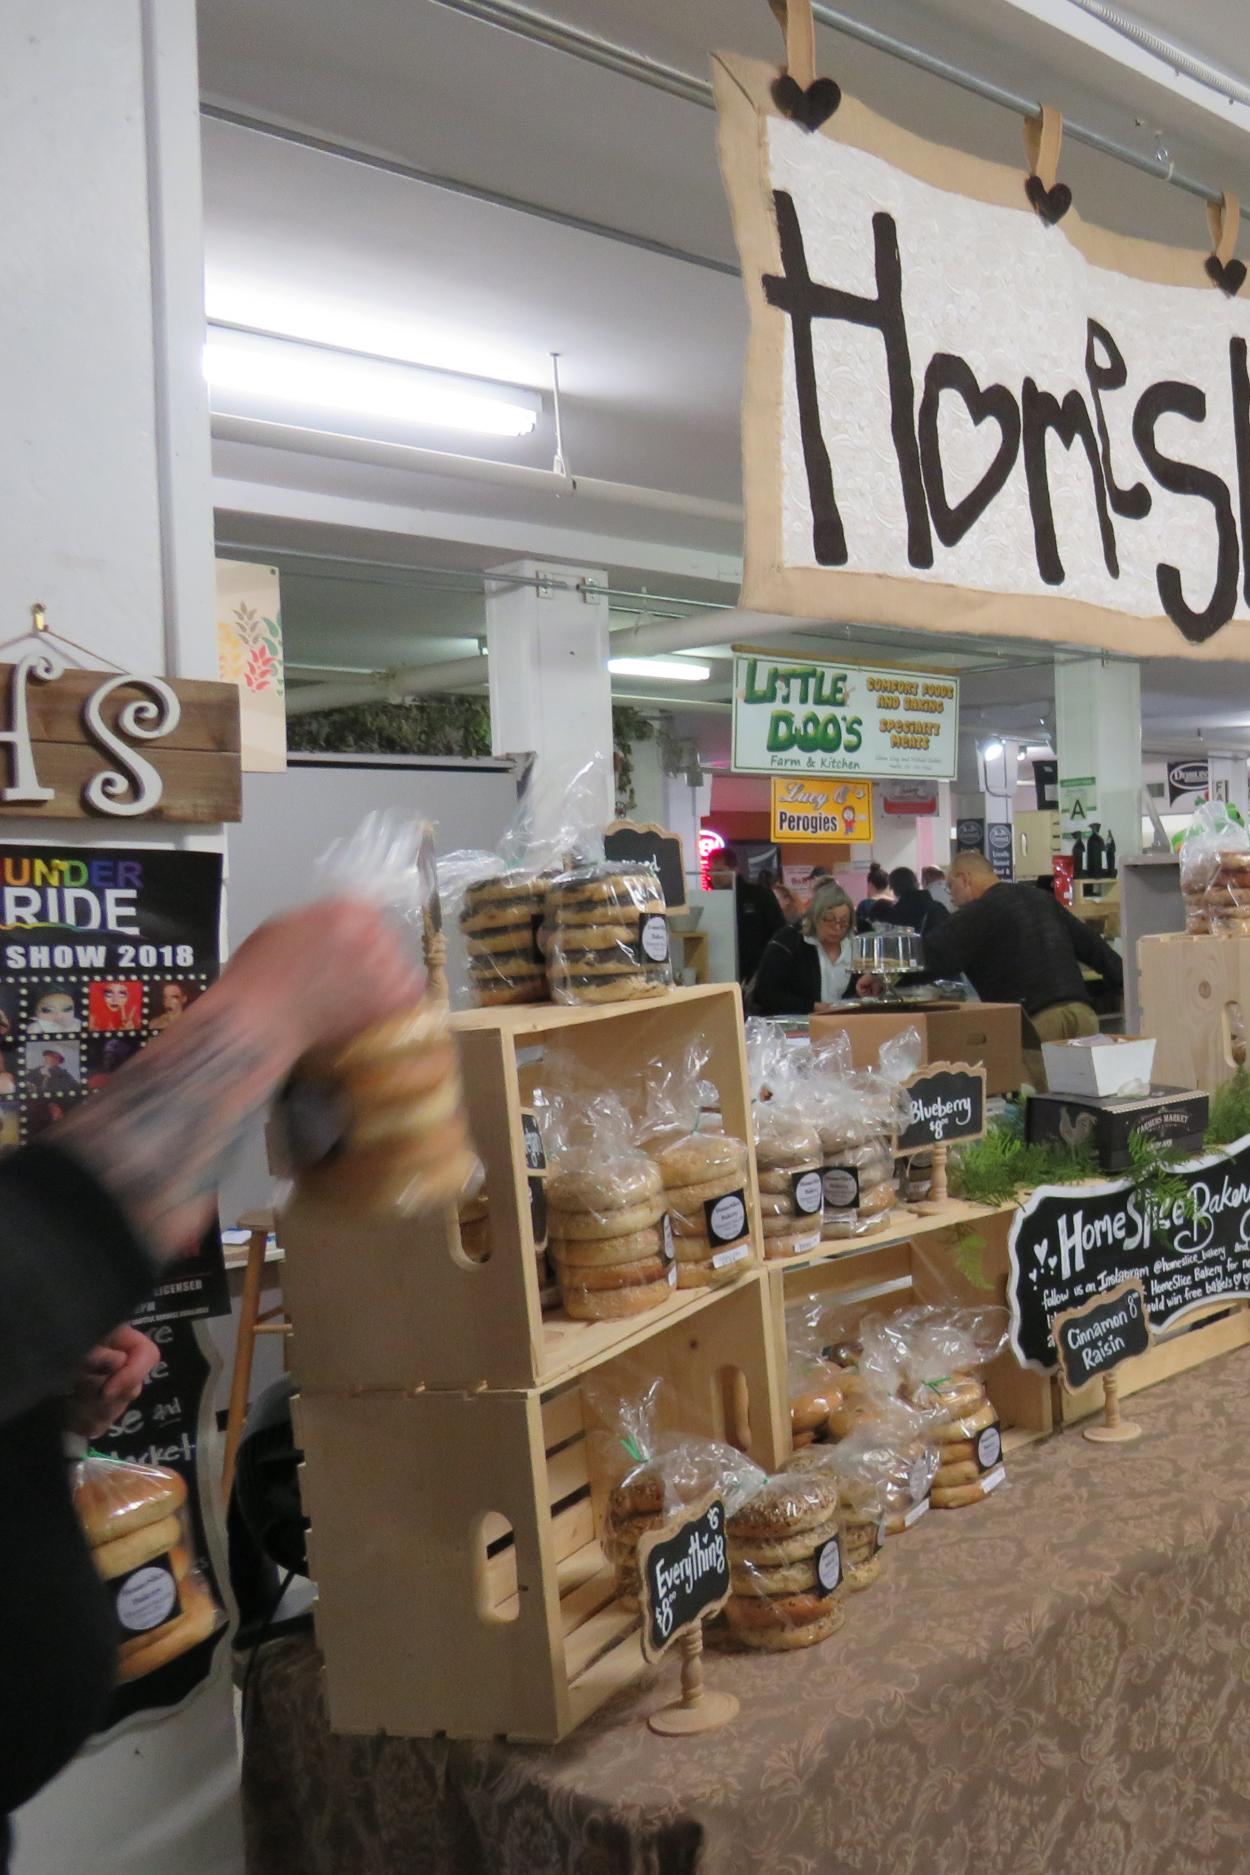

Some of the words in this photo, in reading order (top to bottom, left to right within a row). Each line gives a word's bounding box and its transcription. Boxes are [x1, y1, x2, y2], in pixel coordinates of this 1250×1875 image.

[744, 657, 848, 707] LITTLE
[866, 676, 919, 696] COMFORT
[770, 755, 801, 768] Farm
[806, 757, 816, 767] &
[820, 757, 861, 770] Kitchen
[779, 811, 838, 834] Perogies
[0, 857, 144, 888] UNDER
[6, 945, 108, 969] SHOW
[118, 945, 194, 967] 2018
[911, 1096, 972, 1126] Blueberry
[1194, 1264, 1223, 1282] Bakery
[1226, 1257, 1239, 1272] for
[1042, 1288, 1069, 1311] follow
[1074, 1284, 1084, 1297] us
[1167, 1292, 1182, 1307] win
[1184, 1287, 1202, 1301] free
[1067, 1310, 1128, 1350] Cinnamon
[1082, 1335, 1125, 1371] Raisin
[656, 1531, 725, 1600] Everything
